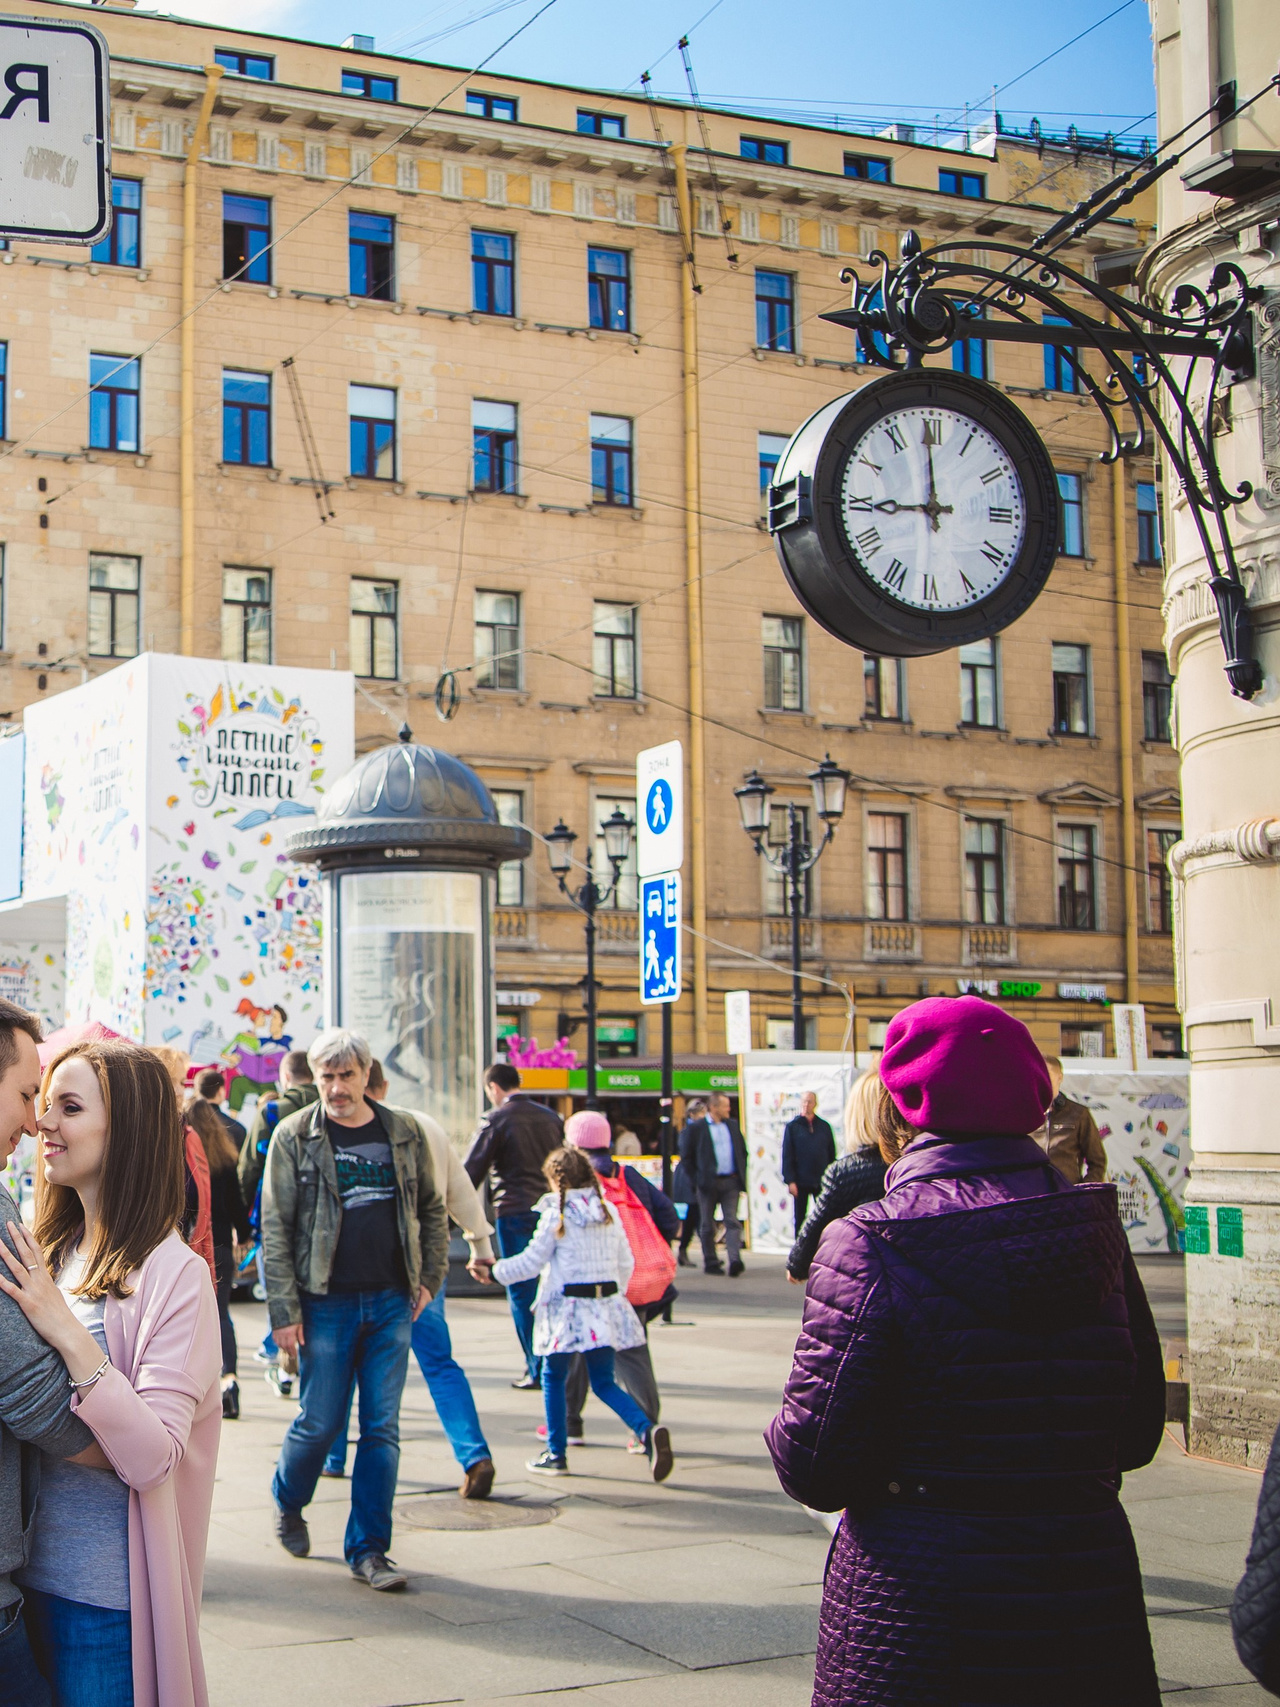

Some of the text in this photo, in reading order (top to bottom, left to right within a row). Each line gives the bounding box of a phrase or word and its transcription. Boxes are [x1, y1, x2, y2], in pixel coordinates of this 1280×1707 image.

[884, 424, 909, 454] XI
[858, 454, 883, 477] X
[980, 467, 1004, 485] II
[989, 506, 1012, 524] III
[883, 558, 909, 593] VII
[923, 573, 940, 601] VI
[217, 729, 294, 754] ЛЕТНИЕ
[209, 770, 298, 803] АЛЛЕИ
[1001, 980, 1042, 997] SHOP
[608, 1075, 641, 1086] КАССА
